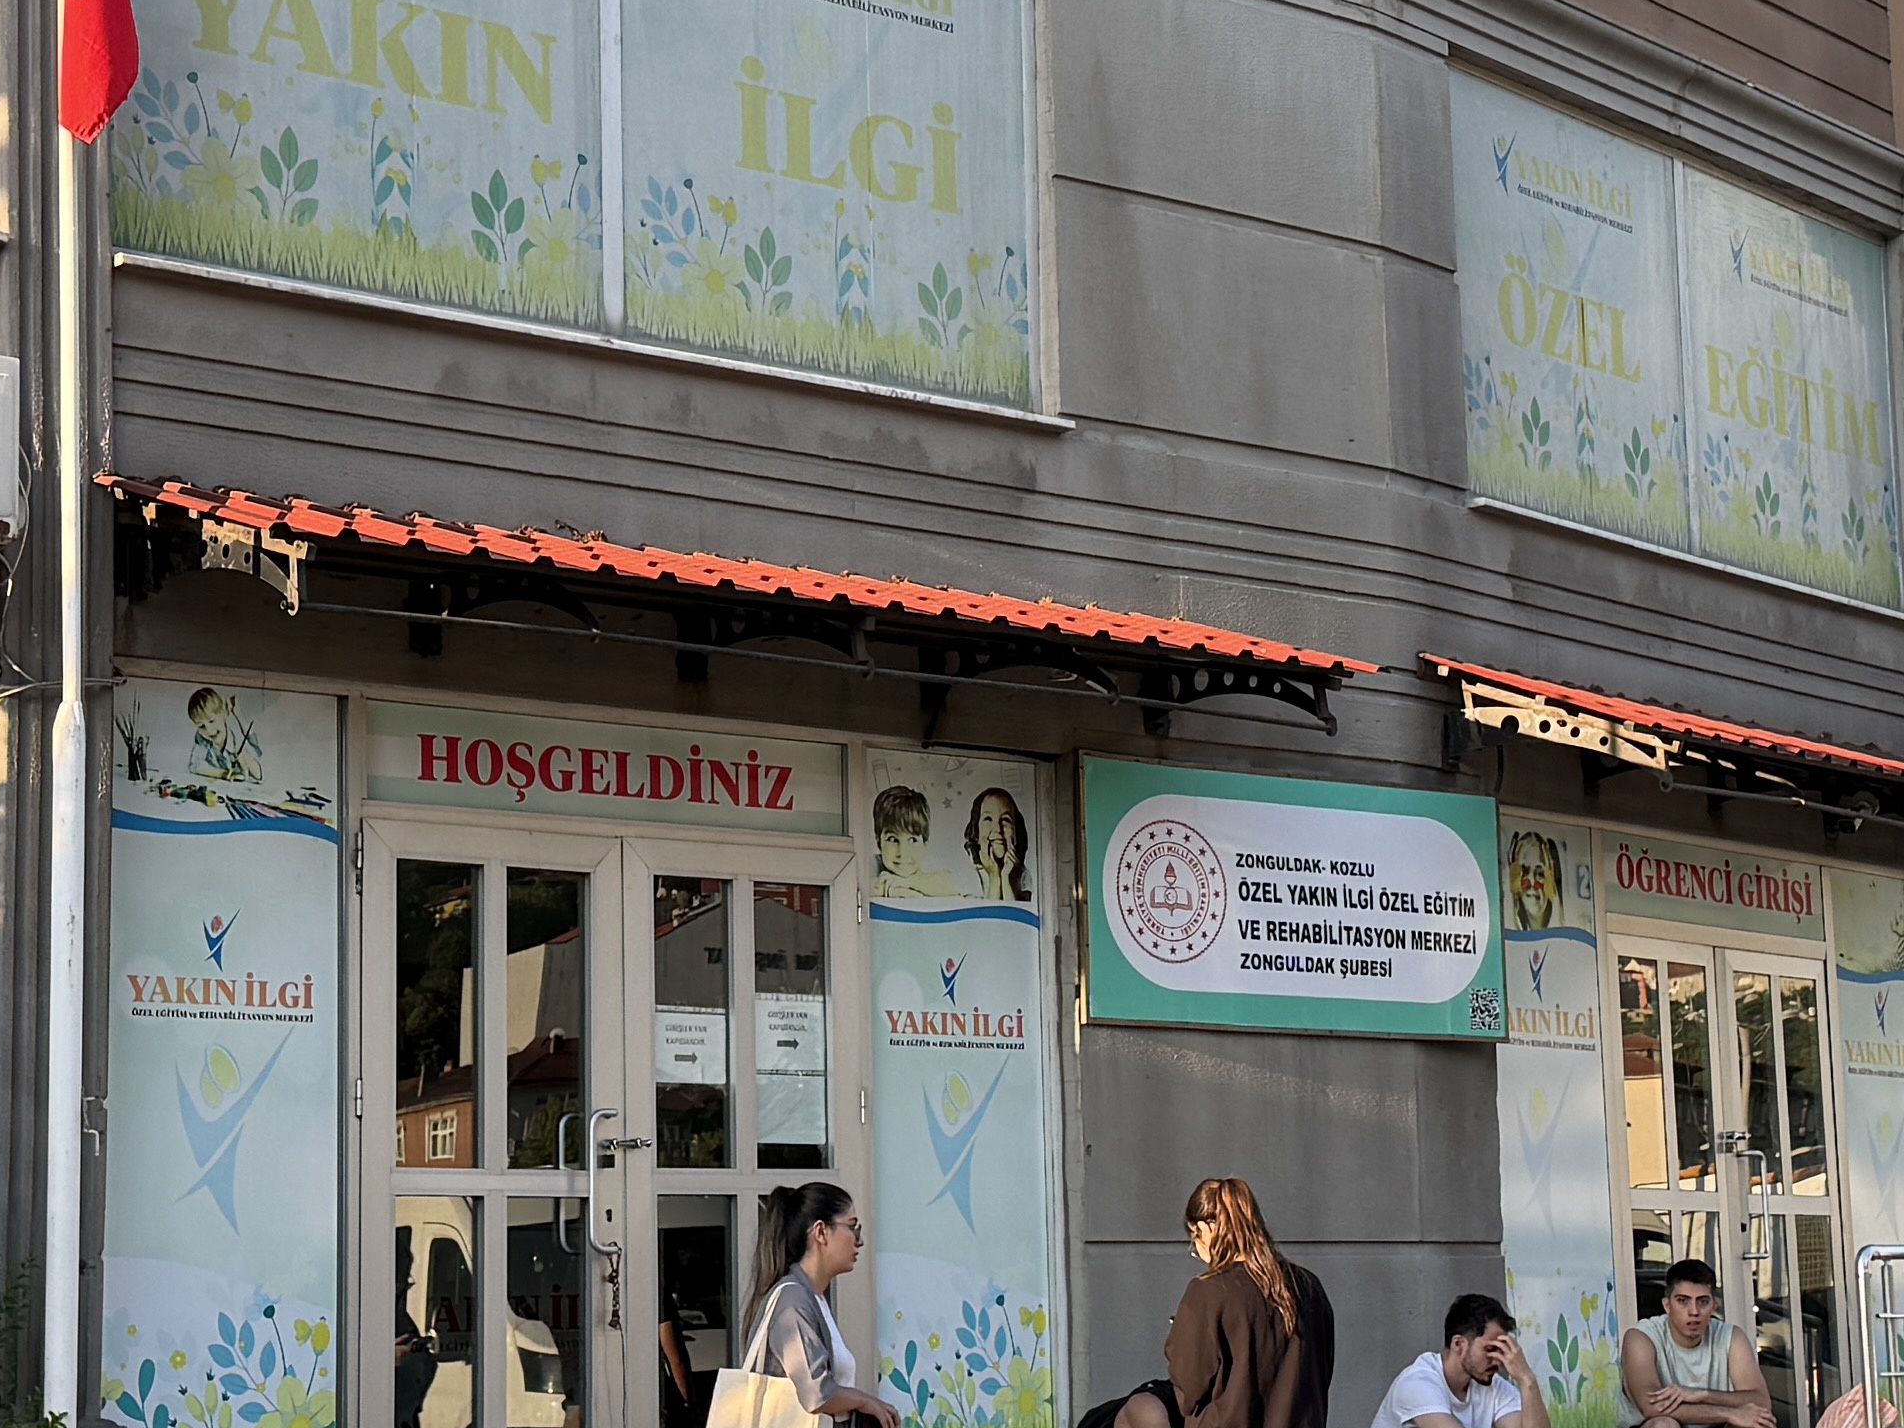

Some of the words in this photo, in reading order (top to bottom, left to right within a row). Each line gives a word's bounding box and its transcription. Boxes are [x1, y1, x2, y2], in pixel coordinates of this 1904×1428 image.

[734, 55, 963, 215] İLGİ
[1497, 250, 1641, 383] ÖZEL
[1704, 345, 1884, 468] EĞİTİM
[417, 733, 794, 811] HOŞGELDİNİZ
[1235, 853, 1326, 874] ZONGULDAK-
[1330, 860, 1375, 878] KOZLU
[1616, 842, 1734, 904] ÖĞRENCİ
[1738, 864, 1813, 924] GİRİŞİ
[1238, 877, 1283, 904] ÖZEL
[1287, 884, 1338, 908] YAKIN
[1343, 883, 1374, 910] İLGİ
[1379, 887, 1419, 914] ÖZEL
[1423, 891, 1475, 918] EĞİTİM
[1237, 919, 1261, 940] VE
[1266, 919, 1406, 950] REHABİLİTASYON
[1411, 930, 1477, 955] MERKEZİ
[1240, 953, 1335, 974] ZONGULDAK
[1340, 958, 1393, 979] ŞUBESİ
[127, 974, 237, 1006] YAKIN
[244, 972, 314, 1010] İLGİ
[885, 1010, 966, 1036] YAKIN
[972, 1006, 1024, 1038] İLGİ
[1508, 1007, 1551, 1034] AKIN
[1555, 1003, 1595, 1039] İLGİ
[1844, 1039, 1893, 1064] YAKIN
